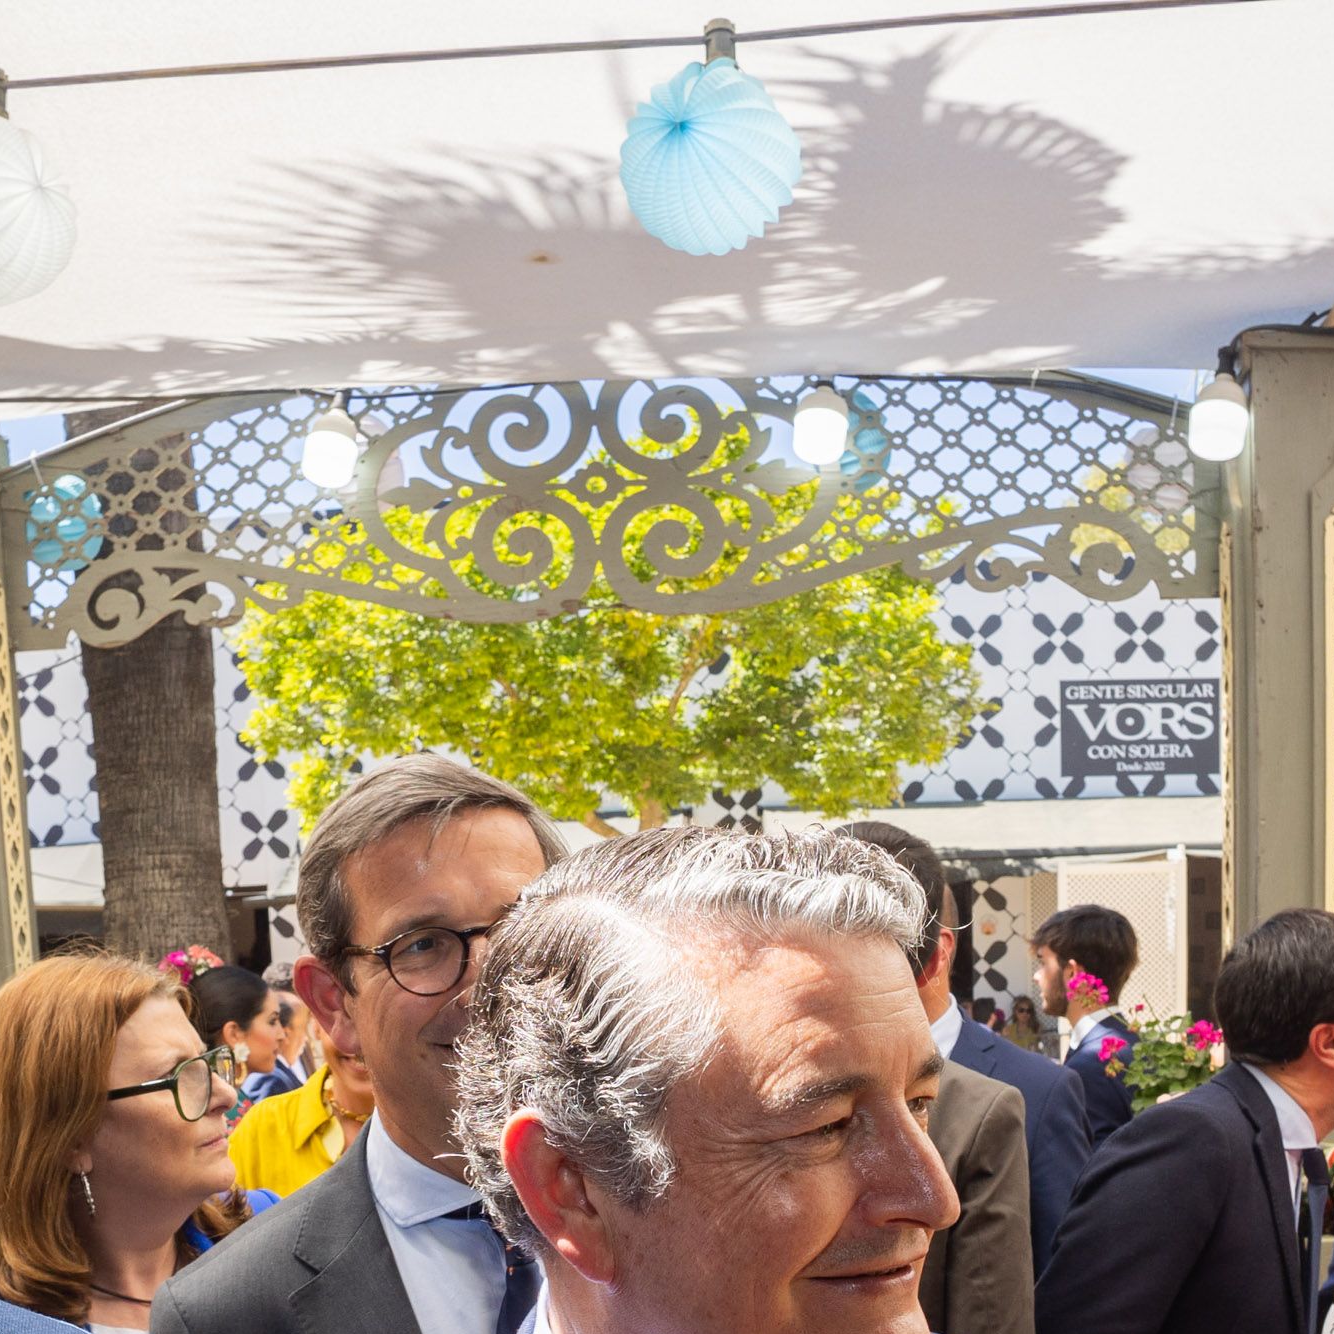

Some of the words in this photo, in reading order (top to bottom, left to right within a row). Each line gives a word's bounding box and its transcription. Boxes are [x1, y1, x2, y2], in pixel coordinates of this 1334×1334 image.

[1065, 684, 1125, 700] GENTE
[1126, 683, 1215, 699] SINGULAR
[1065, 702, 1215, 742] VORS
[1087, 744, 1128, 760] CON
[1128, 743, 1194, 759] SOLERA
[1116, 761, 1144, 772] Desde
